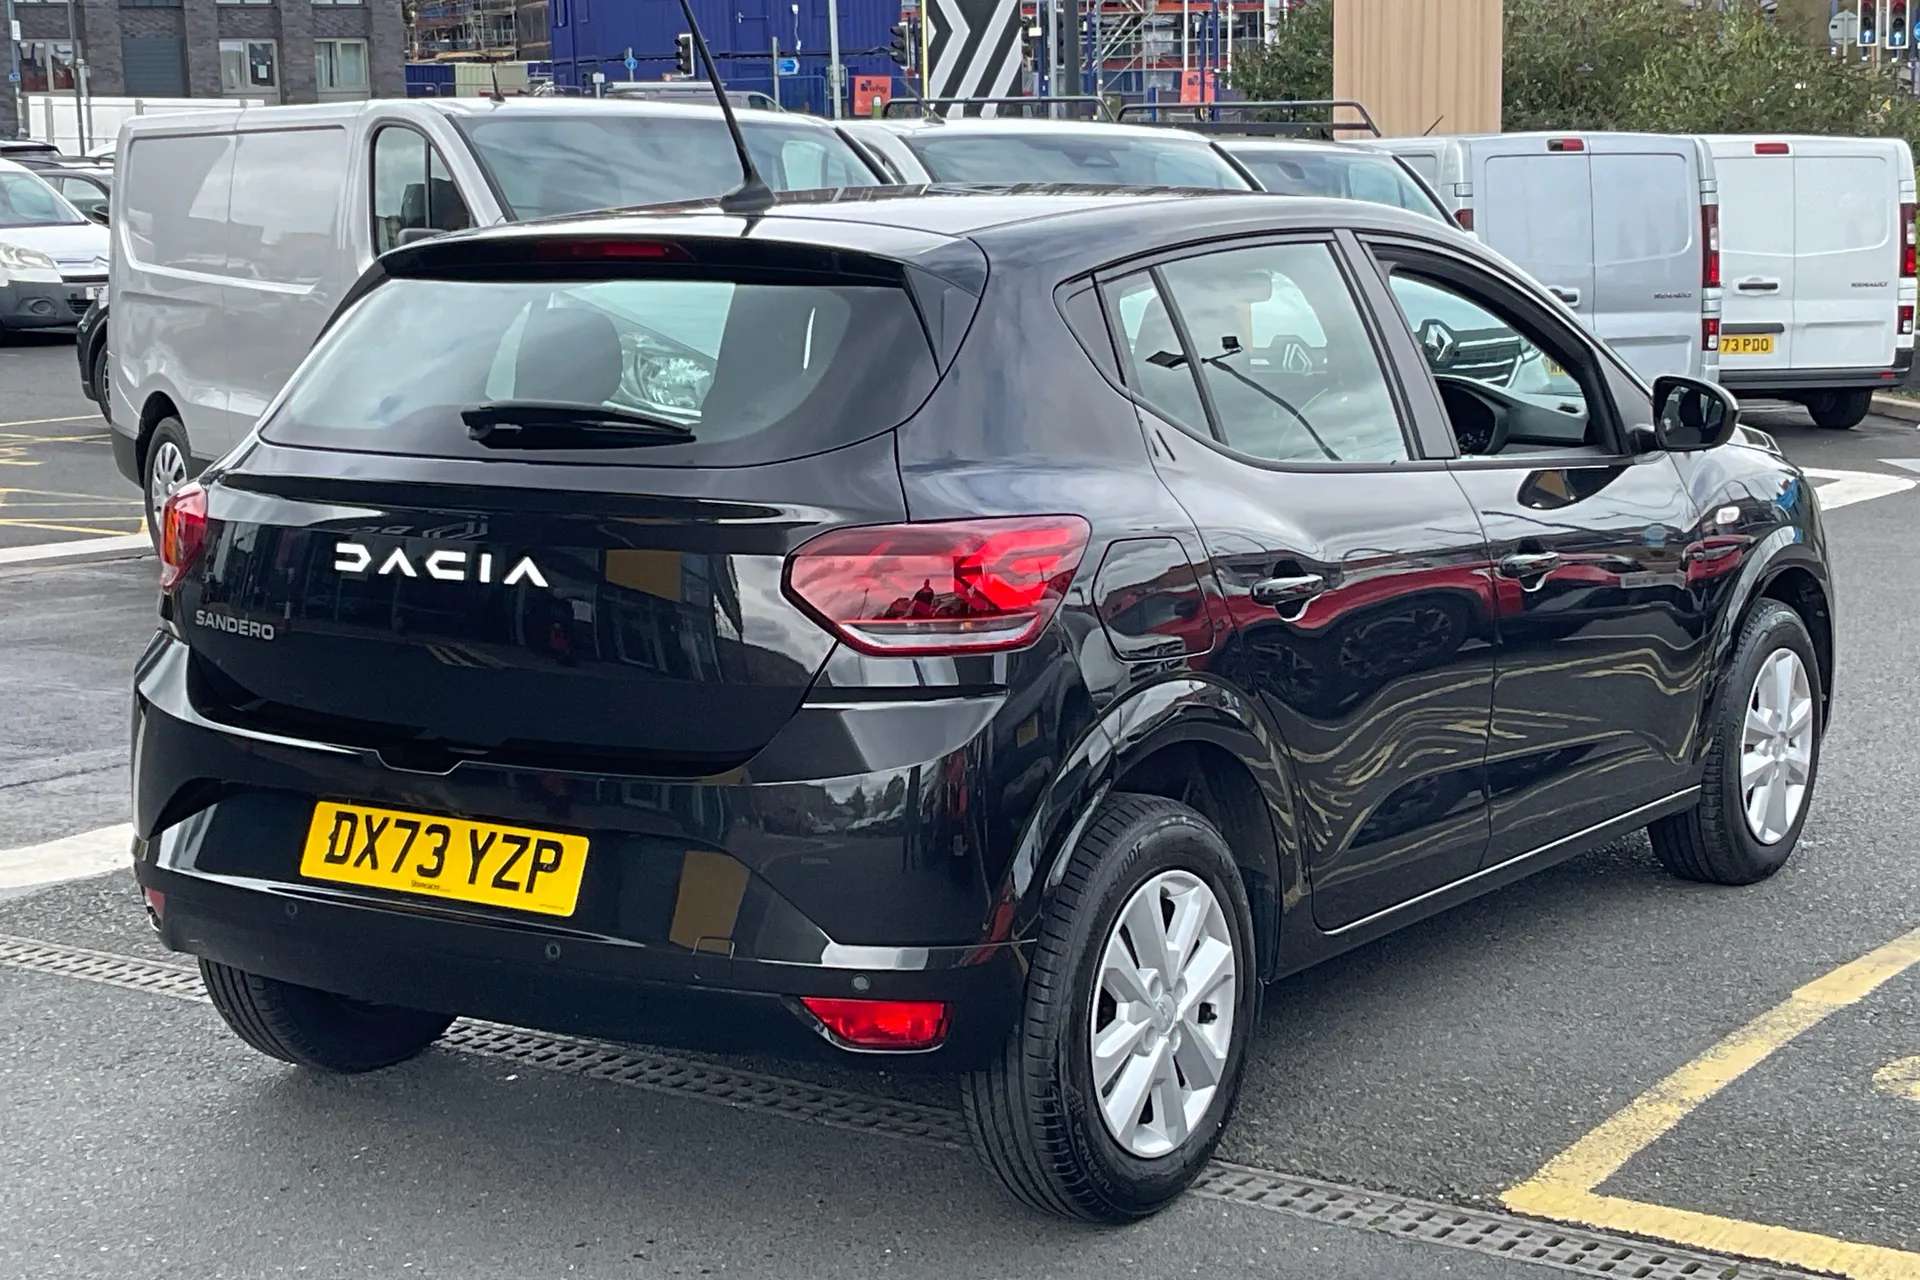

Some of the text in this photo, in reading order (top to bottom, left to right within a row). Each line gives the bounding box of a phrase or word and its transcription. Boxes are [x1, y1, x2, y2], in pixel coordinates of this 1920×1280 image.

[1721, 338, 1769, 352] 73 PDO
[334, 542, 549, 588] DACIA
[195, 609, 275, 641] SANDERO
[323, 810, 565, 894] DX73 YZP
